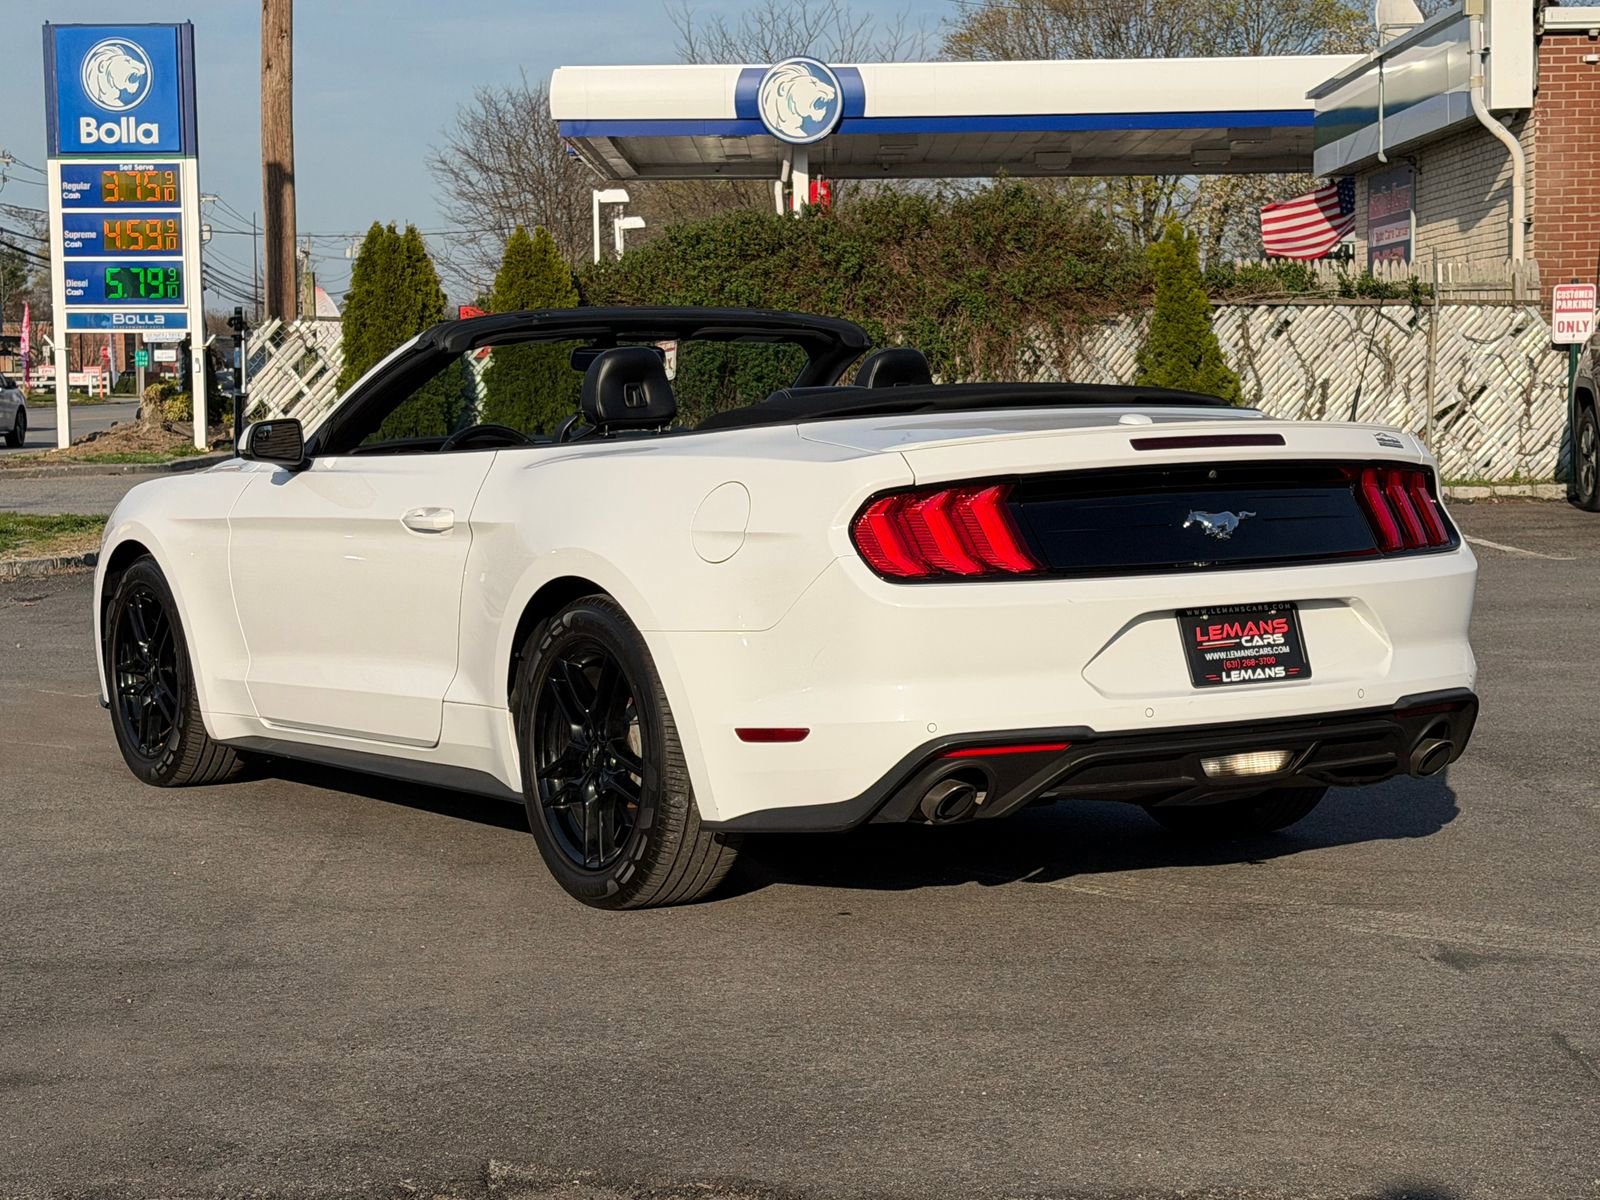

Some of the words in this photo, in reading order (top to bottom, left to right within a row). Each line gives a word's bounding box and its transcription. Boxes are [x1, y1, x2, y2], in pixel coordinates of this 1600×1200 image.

[80, 116, 159, 144] Bolla
[62, 182, 91, 192] Regular
[103, 171, 161, 202] 3.75
[64, 230, 97, 241] Supreme
[103, 219, 163, 250] 4.59
[66, 279, 88, 287] Diesel
[105, 267, 164, 299] 5.79
[66, 288, 84, 296] Cash
[1556, 290, 1594, 299] CUSTOMER
[1556, 299, 1593, 309] PARKING
[1557, 320, 1590, 333] ONLY
[1186, 603, 1291, 616] WWW.LEMANSCARS.COM
[1196, 618, 1289, 642] LEMANS
[1241, 633, 1285, 647] CARS
[1204, 645, 1290, 661] WWW.LEMANSCARS.COM
[1223, 657, 1241, 670] (631)
[1242, 656, 1276, 667] 268-3700
[1222, 666, 1286, 683] LEMANS
